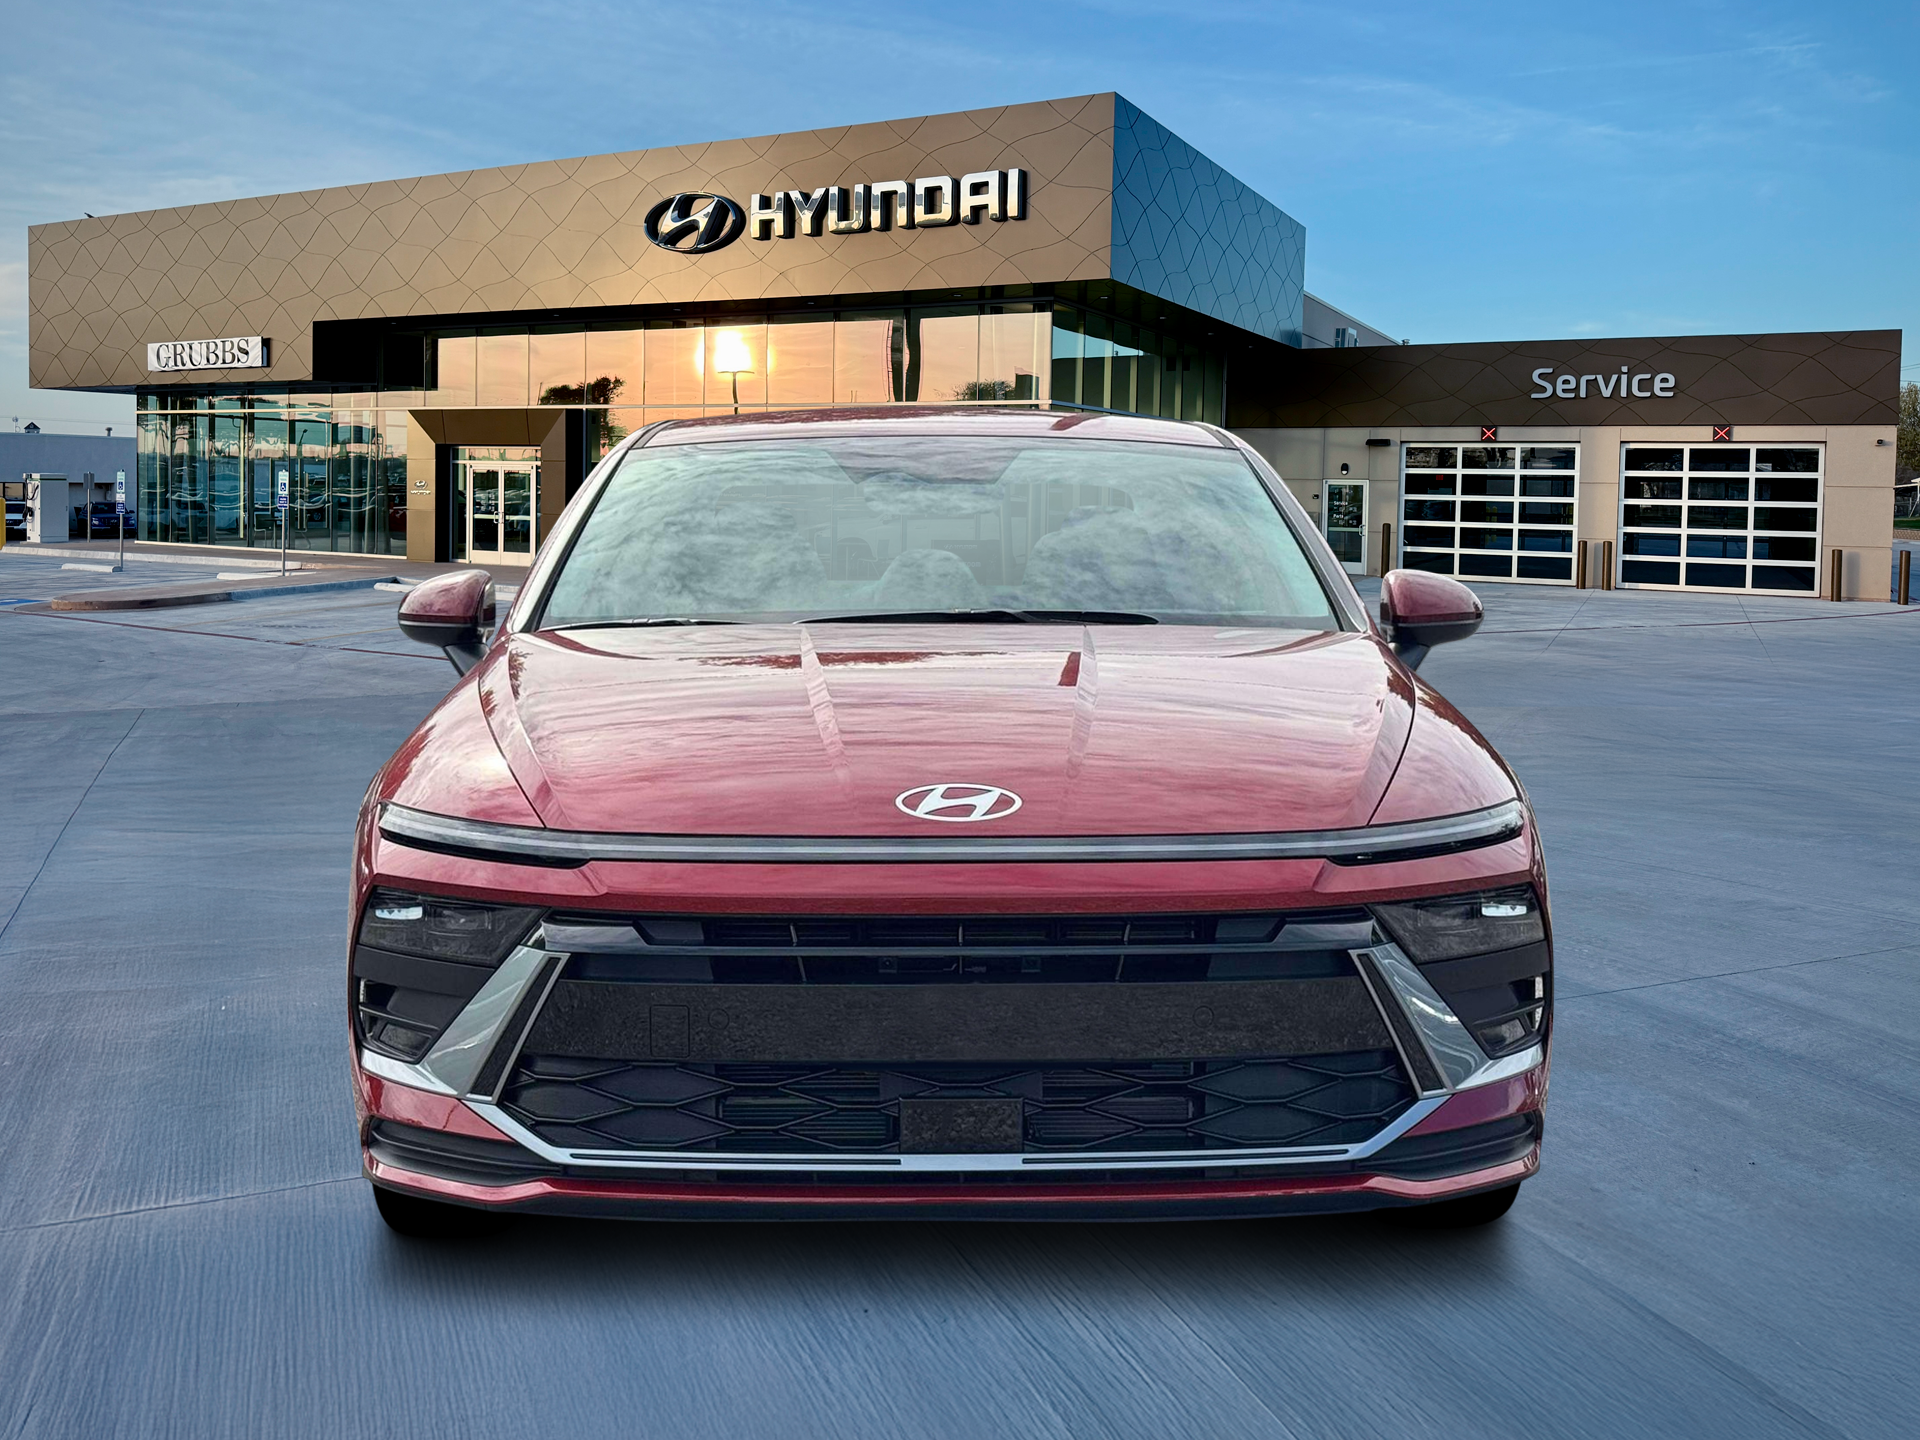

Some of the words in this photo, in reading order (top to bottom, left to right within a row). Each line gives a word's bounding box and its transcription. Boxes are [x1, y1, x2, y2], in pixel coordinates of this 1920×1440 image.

[750, 168, 1026, 241] HYUNDAI
[156, 338, 250, 369] GRUBBS
[1530, 365, 1676, 399] Service
